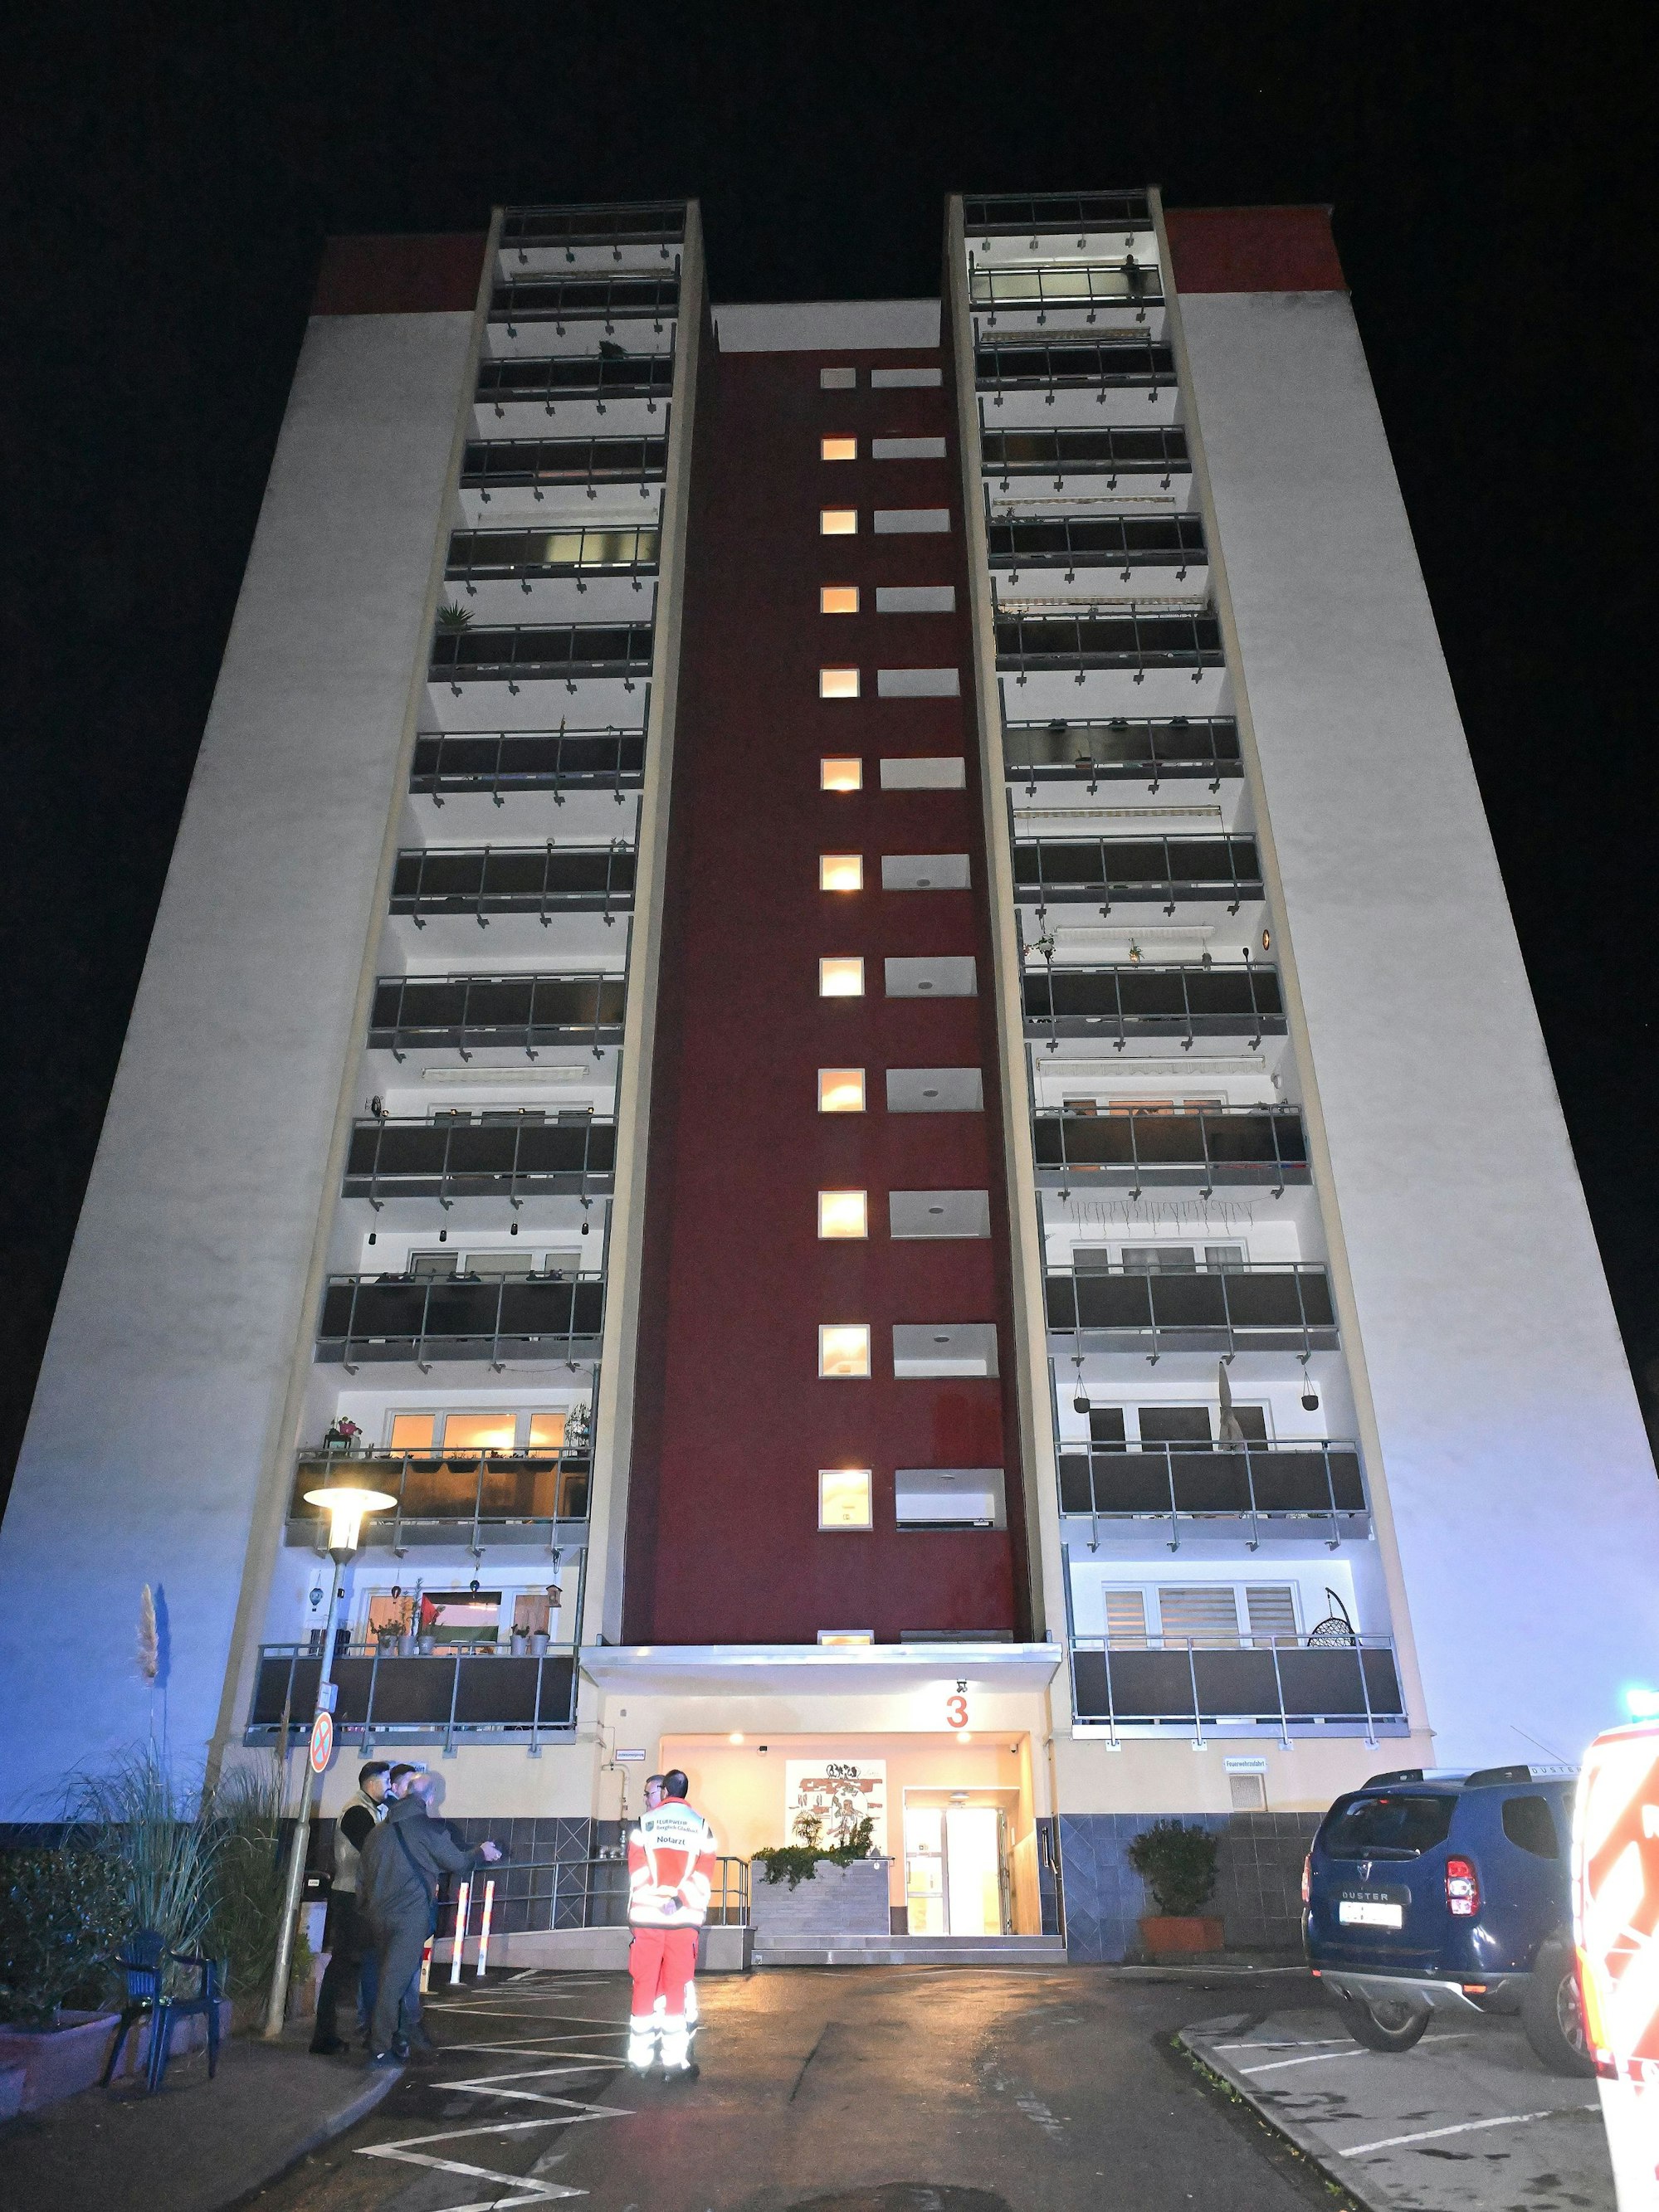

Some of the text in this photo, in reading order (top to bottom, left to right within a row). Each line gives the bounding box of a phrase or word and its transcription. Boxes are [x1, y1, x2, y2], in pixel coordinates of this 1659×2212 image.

[947, 1696, 968, 1727] 3
[656, 1835, 686, 1845] Notarzt
[1342, 1892, 1388, 1901] DUSTER
